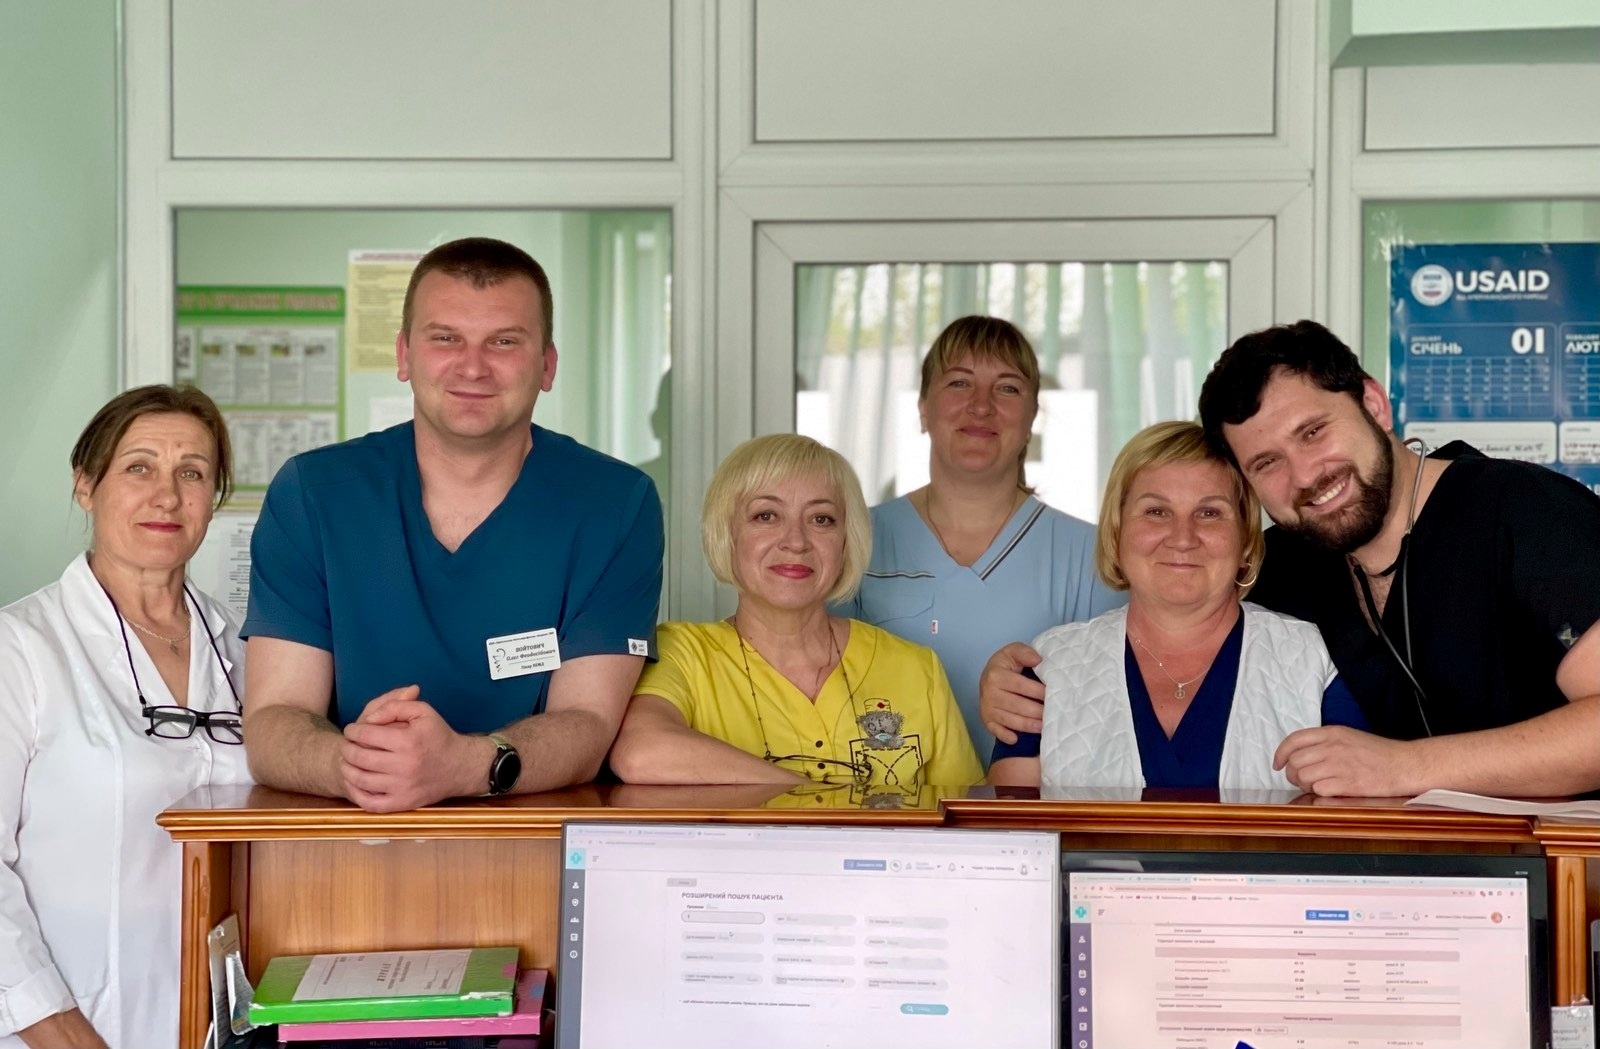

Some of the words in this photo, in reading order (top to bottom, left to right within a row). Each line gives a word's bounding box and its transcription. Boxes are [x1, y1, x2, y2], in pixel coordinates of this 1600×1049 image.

[1455, 269, 1550, 293] USAID
[1410, 342, 1463, 355] СІЧЕНЬ
[1511, 327, 1545, 354] 01
